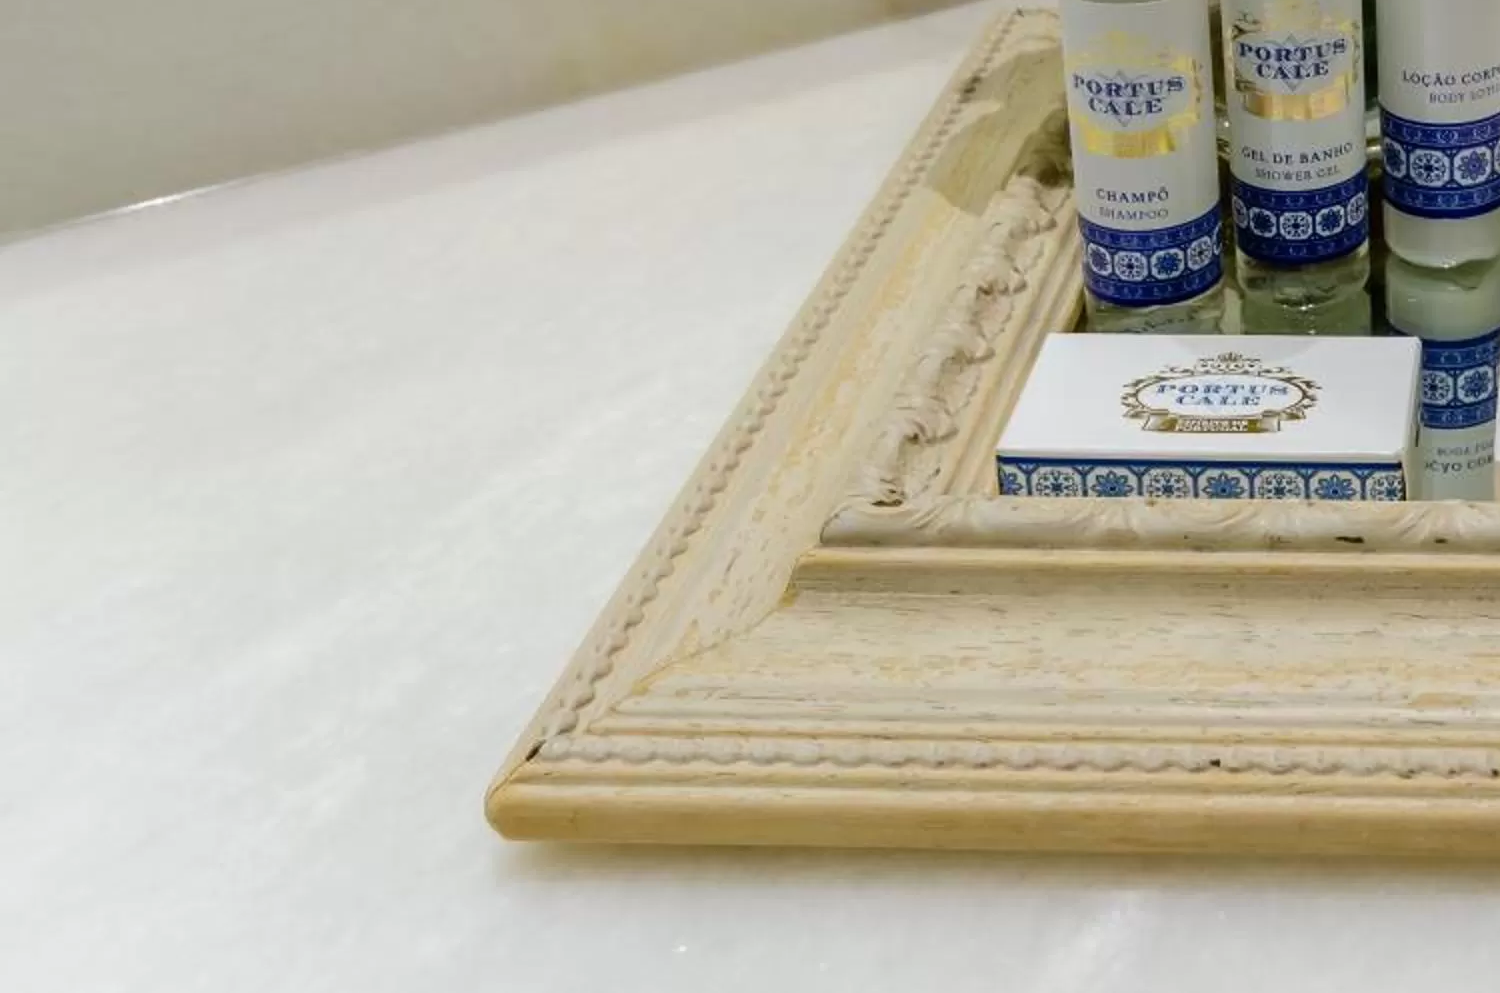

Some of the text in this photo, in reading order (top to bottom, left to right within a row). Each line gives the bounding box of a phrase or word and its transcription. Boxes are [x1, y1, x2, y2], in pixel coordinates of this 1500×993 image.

[1238, 38, 1346, 62] PORTUS
[1255, 60, 1329, 80] CALE
[1402, 70, 1457, 87] LOÇÃO
[1073, 73, 1184, 98] PORTUS
[1088, 97, 1164, 116] CALE
[1429, 92, 1466, 104] BODY
[1241, 142, 1353, 165] GEL DE BANHO
[1255, 164, 1340, 182] SHOWER GEL
[1096, 186, 1169, 204] CHAMPÔ
[1099, 206, 1169, 220] SHAMPOO
[1156, 383, 1289, 396] PORTUS
[1175, 395, 1261, 407] CALE
